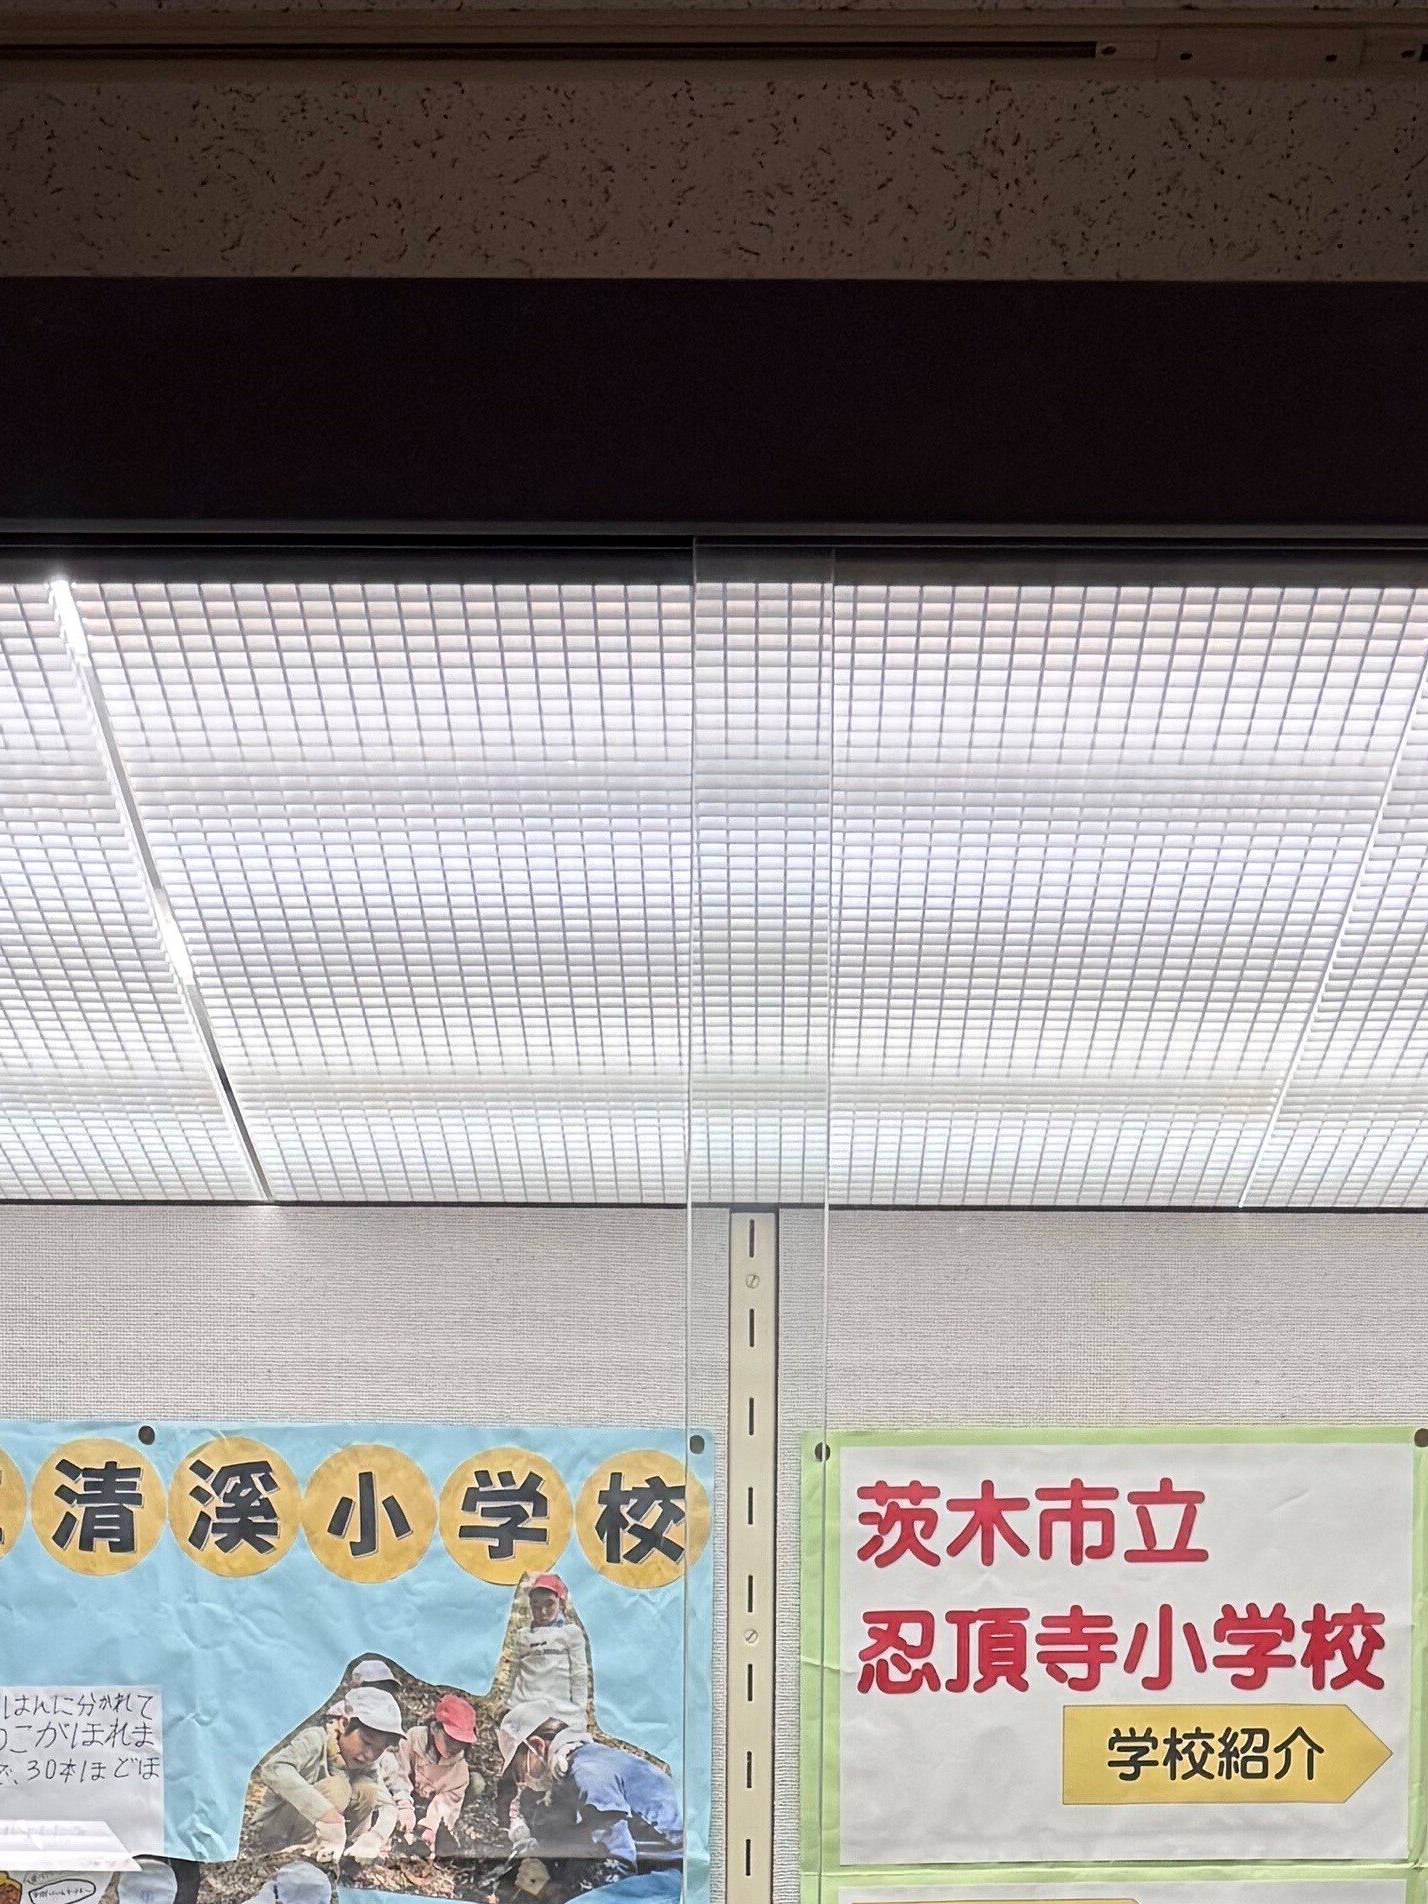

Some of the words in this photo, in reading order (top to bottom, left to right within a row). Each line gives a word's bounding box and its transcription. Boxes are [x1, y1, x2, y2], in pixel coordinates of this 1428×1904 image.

[856, 1477, 1210, 1569] 茨木市立
[856, 1602, 1386, 1695] 忍頂寺小学校
[1107, 1725, 1325, 1783] 学校紹介
